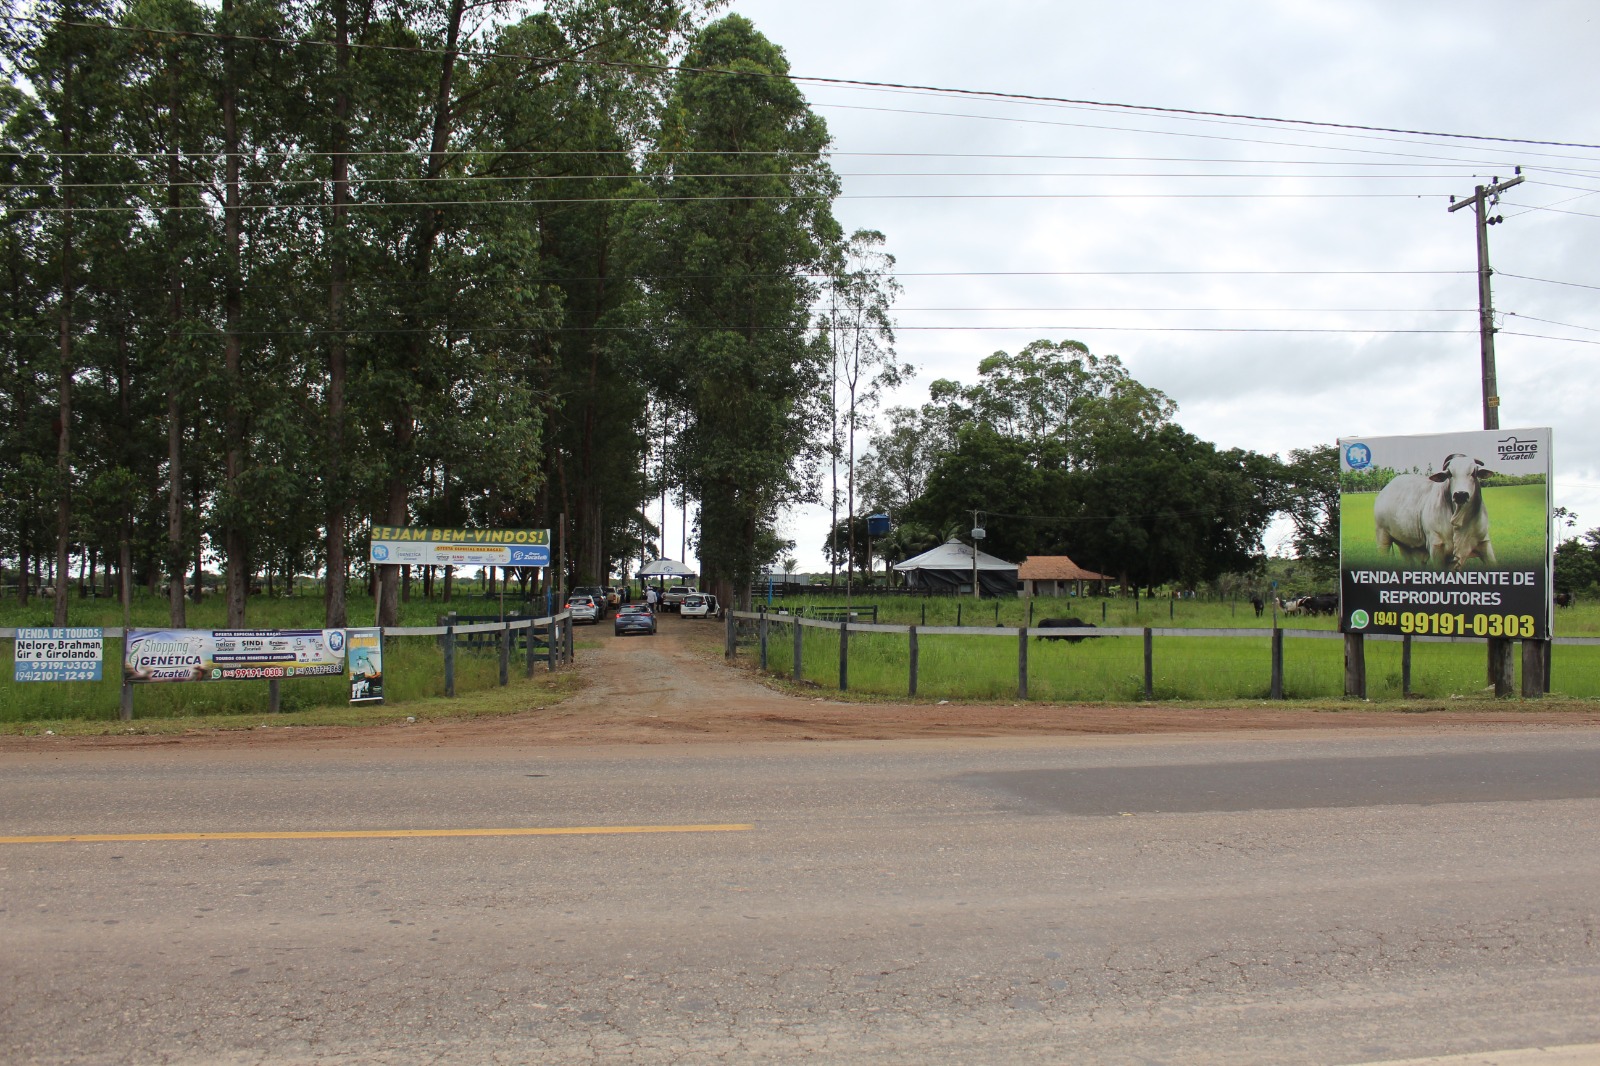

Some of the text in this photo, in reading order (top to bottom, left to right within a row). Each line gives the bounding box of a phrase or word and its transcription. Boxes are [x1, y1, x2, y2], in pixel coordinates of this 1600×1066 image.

[1498, 442, 1538, 452] nelore
[1500, 453, 1536, 461] Zucatelli
[371, 527, 544, 544] SEJAM BEM-VINDOS!
[1351, 571, 1535, 586] VENDA PERMANENTE DE
[1379, 590, 1502, 606] REPRODUTORES
[1373, 611, 1536, 638] (94) 99191-0303
[17, 628, 102, 639] VENDA DE TOUROS:
[17, 640, 102, 650] Nelore, Brahman,
[144, 640, 189, 655] Shopping
[17, 650, 98, 659] Gir e Girolando.
[141, 653, 202, 666] GENÉTICA
[32, 661, 96, 670] 99191-0303
[152, 669, 191, 678] Zucatelli
[235, 667, 284, 678] 99191-0303
